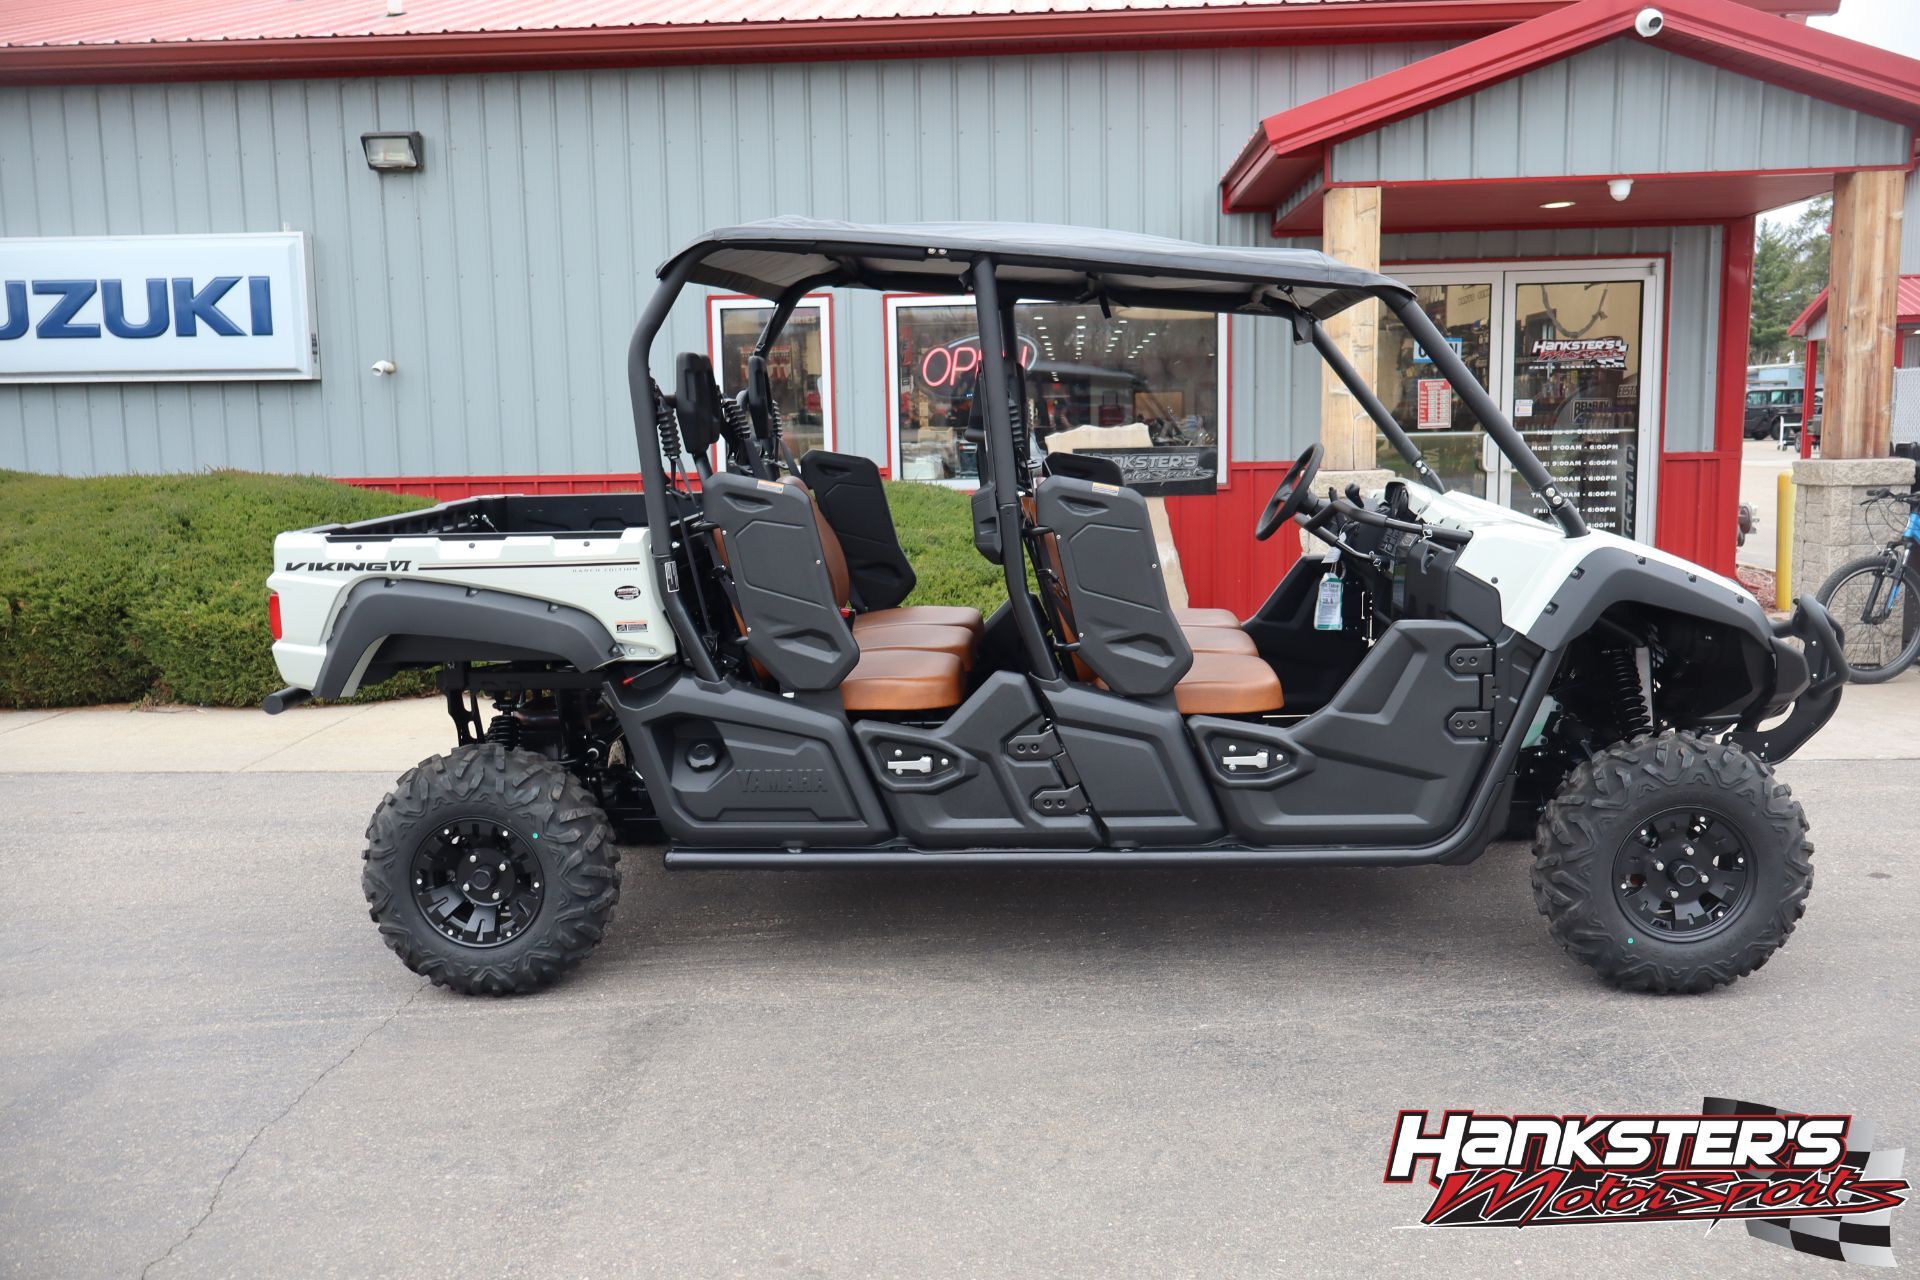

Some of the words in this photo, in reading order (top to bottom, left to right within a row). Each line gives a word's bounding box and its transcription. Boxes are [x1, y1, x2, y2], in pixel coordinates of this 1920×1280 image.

[922, 345, 1028, 387] OP
[285, 562, 388, 571] VIKING
[736, 769, 828, 792] YAMAHA
